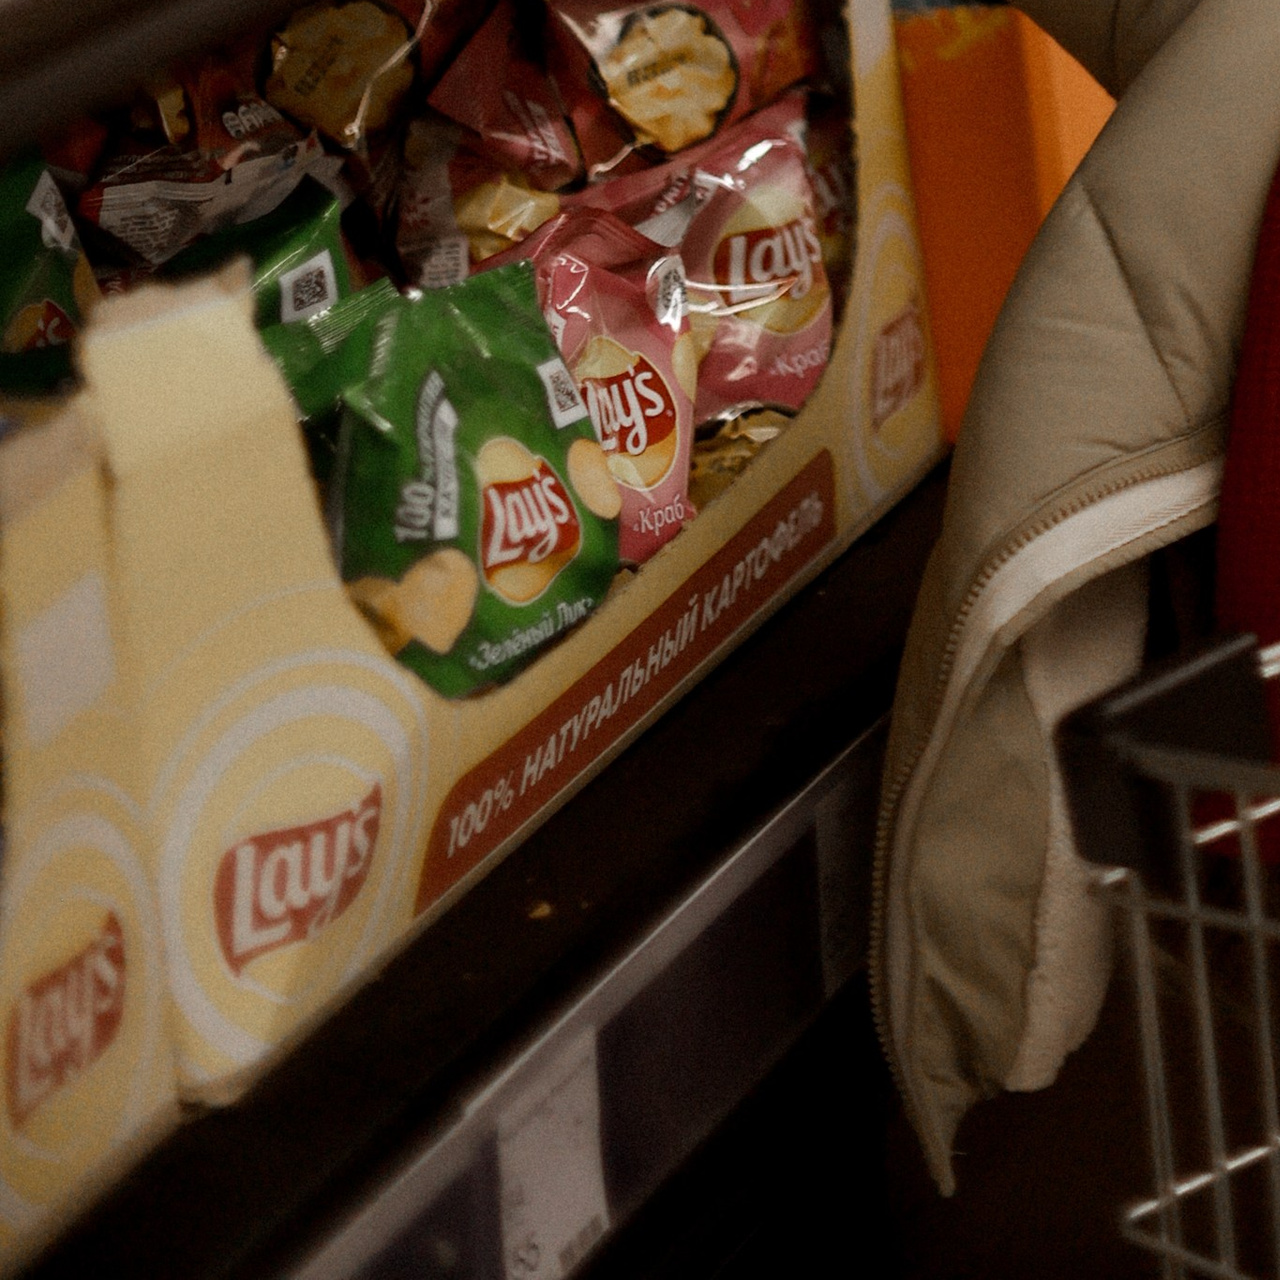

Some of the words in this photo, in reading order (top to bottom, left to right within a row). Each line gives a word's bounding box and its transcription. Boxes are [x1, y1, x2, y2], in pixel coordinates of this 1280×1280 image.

[486, 468, 570, 571] Lay's
[447, 770, 514, 860] 100%
[519, 593, 699, 797] НАТУРАЛЬНЫЙ
[700, 491, 826, 633] КАРТОФЕЛЬ
